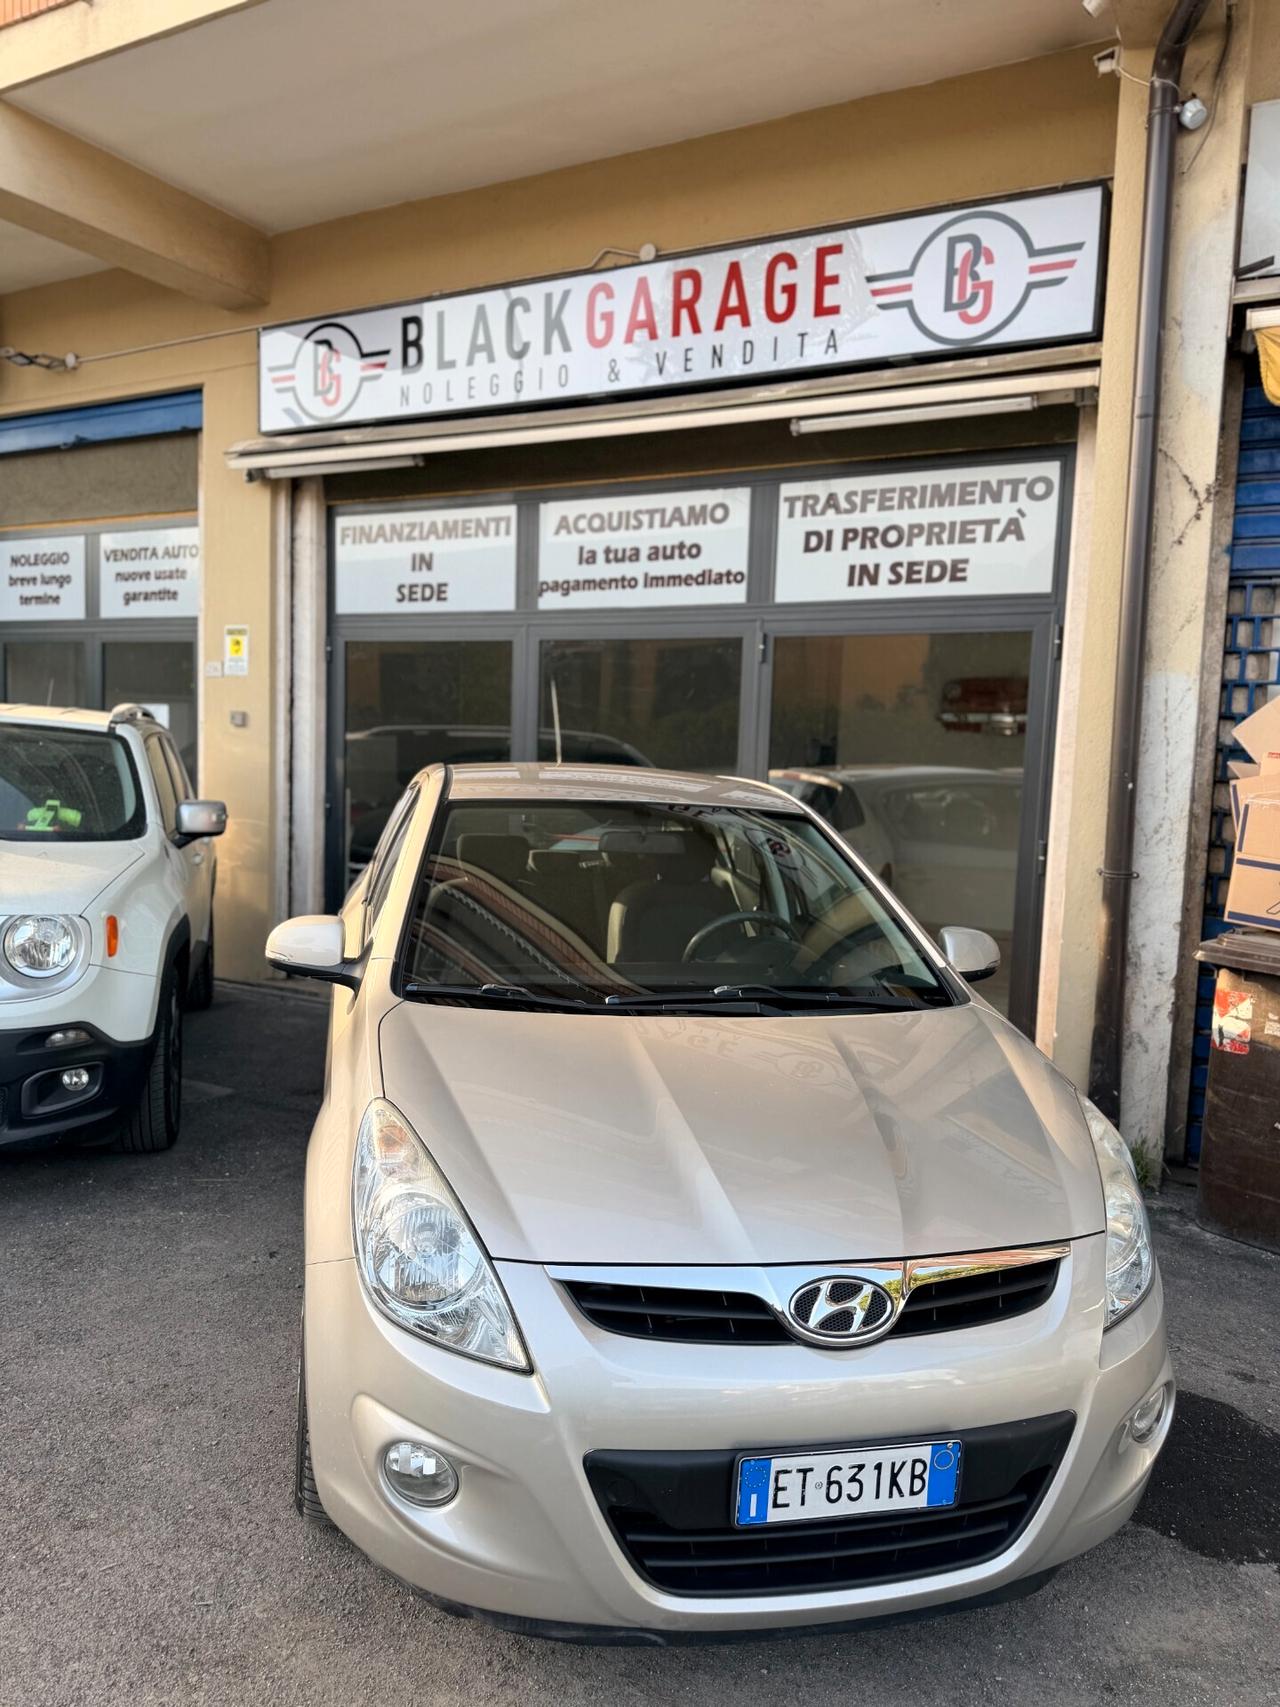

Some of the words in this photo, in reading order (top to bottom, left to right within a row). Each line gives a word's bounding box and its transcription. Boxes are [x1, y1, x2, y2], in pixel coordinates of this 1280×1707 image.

[400, 363, 569, 407] NOLEGGIO
[608, 358, 621, 382] &
[656, 328, 838, 376] VENDITA
[784, 475, 1055, 519] TRASFERIMENTO
[554, 502, 730, 536] ACQUISTIAMO
[340, 515, 512, 546] FINANZIAMENTI
[803, 529, 833, 553] DI
[841, 507, 1026, 551] PROPRIETÀ
[10, 552, 70, 567] NOLEGGIO
[104, 547, 159, 563] VENDITA
[161, 544, 199, 560] AUTO
[411, 552, 434, 572] IN
[578, 546, 597, 566] la
[604, 547, 641, 564] tua
[647, 541, 702, 562] auto
[8, 574, 38, 586] breve
[40, 571, 72, 588] lungo
[115, 572, 151, 583] nuove
[154, 568, 187, 581] usate
[847, 563, 880, 587] IN
[887, 558, 969, 585] SEDE
[123, 588, 179, 606] garantite
[396, 583, 449, 602] SEDE
[538, 576, 639, 598] pagamento
[19, 592, 61, 605] termine
